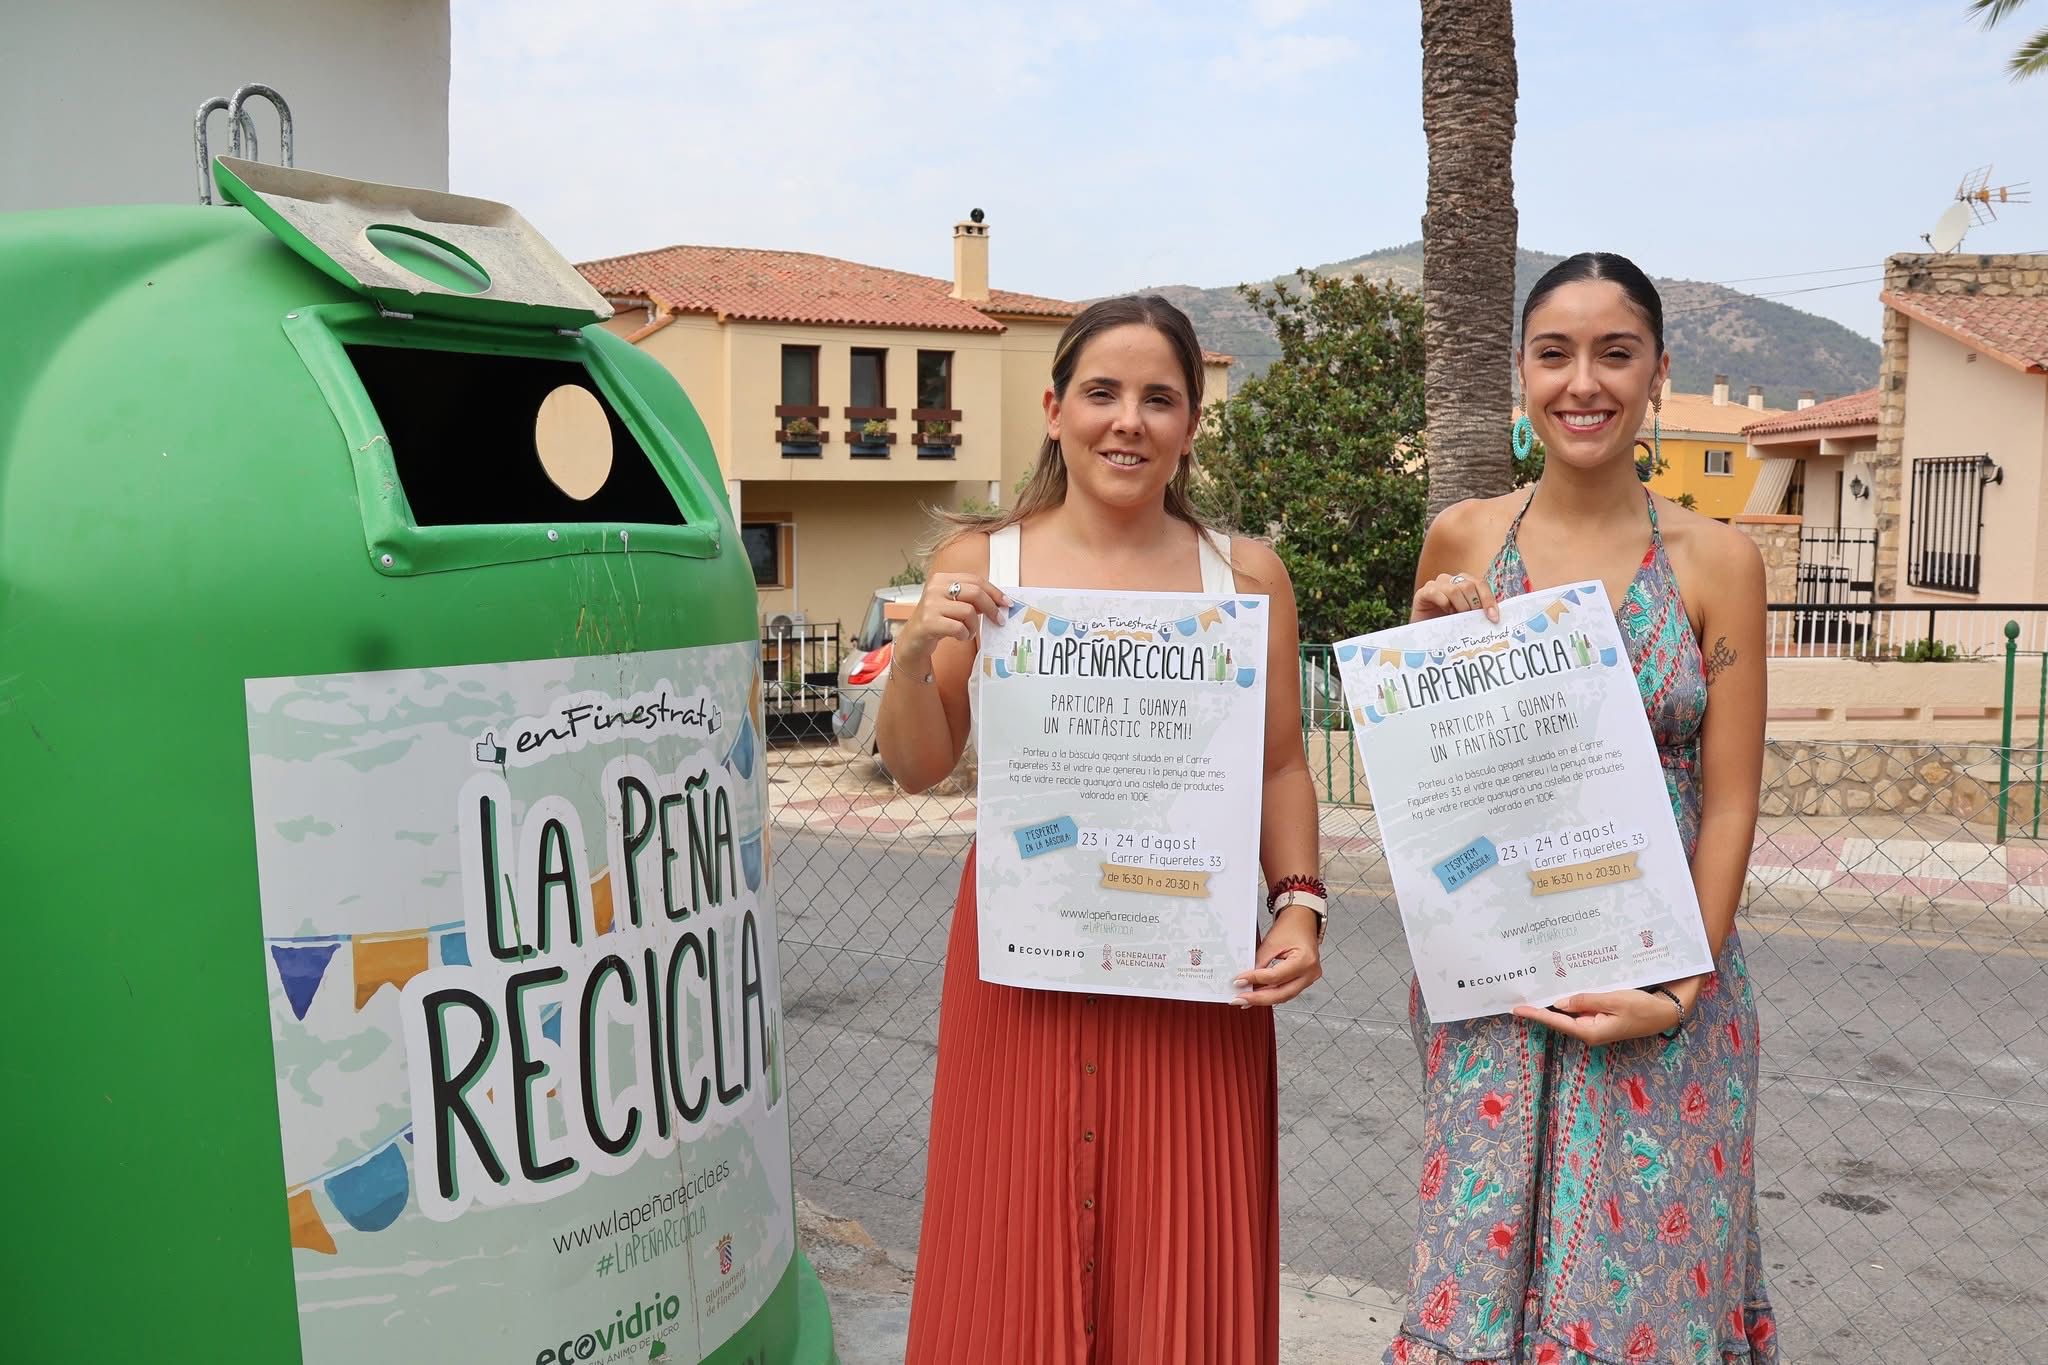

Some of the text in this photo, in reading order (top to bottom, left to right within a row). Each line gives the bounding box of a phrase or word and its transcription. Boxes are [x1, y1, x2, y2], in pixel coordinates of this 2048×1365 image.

[1091, 616, 1157, 630] en Finestrat
[1447, 626, 1510, 653] en Finestrat
[1038, 637, 1205, 681] LAPEÑARECICLA
[1401, 639, 1572, 708] LAPEÑARECICLA
[1051, 694, 1187, 717] PARTICIPA I GUANYA
[1430, 691, 1567, 739] PARTICIPA I GUANYA
[1043, 716, 1193, 740] UN FANTÀSTIC PREMI!
[1429, 712, 1579, 763] UN FANTÀSTIC PREMI!
[1022, 747, 1050, 757] Porteu
[1051, 750, 1058, 758] a
[1059, 749, 1067, 758] la
[1102, 752, 1130, 763] gegant
[1132, 753, 1161, 763] situada
[1163, 755, 1175, 763] en
[1176, 754, 1184, 764] el
[1185, 754, 1212, 765] Carrer
[1418, 778, 1446, 791] Porteu
[1455, 773, 1464, 782] la
[1498, 758, 1525, 773] gegant
[1527, 751, 1556, 764] situada
[1558, 748, 1569, 757] en
[1570, 744, 1578, 754] el
[1580, 740, 1604, 751] Carrer
[1008, 759, 1049, 771] Figueretes
[1051, 761, 1061, 771] 33
[1063, 763, 1071, 772] el
[1073, 763, 1093, 773] vidre
[1095, 766, 1111, 775] que
[1112, 766, 1146, 776] genereu
[1152, 767, 1160, 776] la
[1162, 768, 1188, 779] penya
[1190, 769, 1206, 779] que
[1009, 773, 1020, 784] kg
[1021, 773, 1032, 783] de
[1034, 775, 1054, 784] vidre
[1055, 776, 1081, 785] recicle
[1124, 780, 1140, 788] una
[1142, 780, 1169, 790] cistella
[1170, 781, 1181, 790] de
[1183, 782, 1225, 792] productes
[1407, 791, 1449, 808] Figueretes
[1451, 786, 1462, 797] 33
[1463, 784, 1471, 794] el
[1473, 780, 1493, 792] vidre
[1495, 776, 1510, 787] que
[1512, 768, 1545, 783] genereu
[1550, 763, 1559, 772] la
[1560, 758, 1586, 772] penya
[1587, 753, 1603, 764] que
[1080, 791, 1149, 802] valorada en 100€
[1412, 811, 1424, 821] kg
[1424, 808, 1436, 817] de
[1437, 802, 1458, 814] vidre
[1459, 796, 1485, 808] recicle
[1526, 783, 1543, 792] una
[1572, 771, 1584, 781] de
[1585, 763, 1625, 779] productes
[1487, 791, 1557, 815] valorada en 100€
[1025, 843, 1034, 854] EN
[1036, 841, 1043, 850] LA
[1081, 832, 1197, 853] 23 i 24 d'agost
[1501, 822, 1616, 861] 23 i 24 d'agost
[1534, 833, 1645, 869] Carrer Figueretes 33
[479, 768, 740, 963] LA PEÑA
[1111, 851, 1222, 867] Carrer Figueretes 33
[1107, 872, 1120, 882] de
[1147, 876, 1154, 886] h
[1192, 880, 1200, 890] h
[1457, 869, 1467, 880] LA
[1537, 878, 1549, 889] de
[1577, 871, 1584, 881] h
[1585, 871, 1593, 880] a
[1622, 863, 1631, 873] h
[1019, 946, 1085, 959] ECOVIDRIO
[1115, 951, 1167, 961] GENERALITAT
[1565, 945, 1618, 962] GENERALITAT
[1568, 953, 1620, 969] VALENCIANA
[1115, 959, 1166, 969] VALENCIANA
[1469, 965, 1537, 987] ECOVIDRIO
[422, 909, 770, 1202] RECICLA
[535, 1292, 681, 1365] ecovidrio
[639, 1336, 651, 1349] DE
